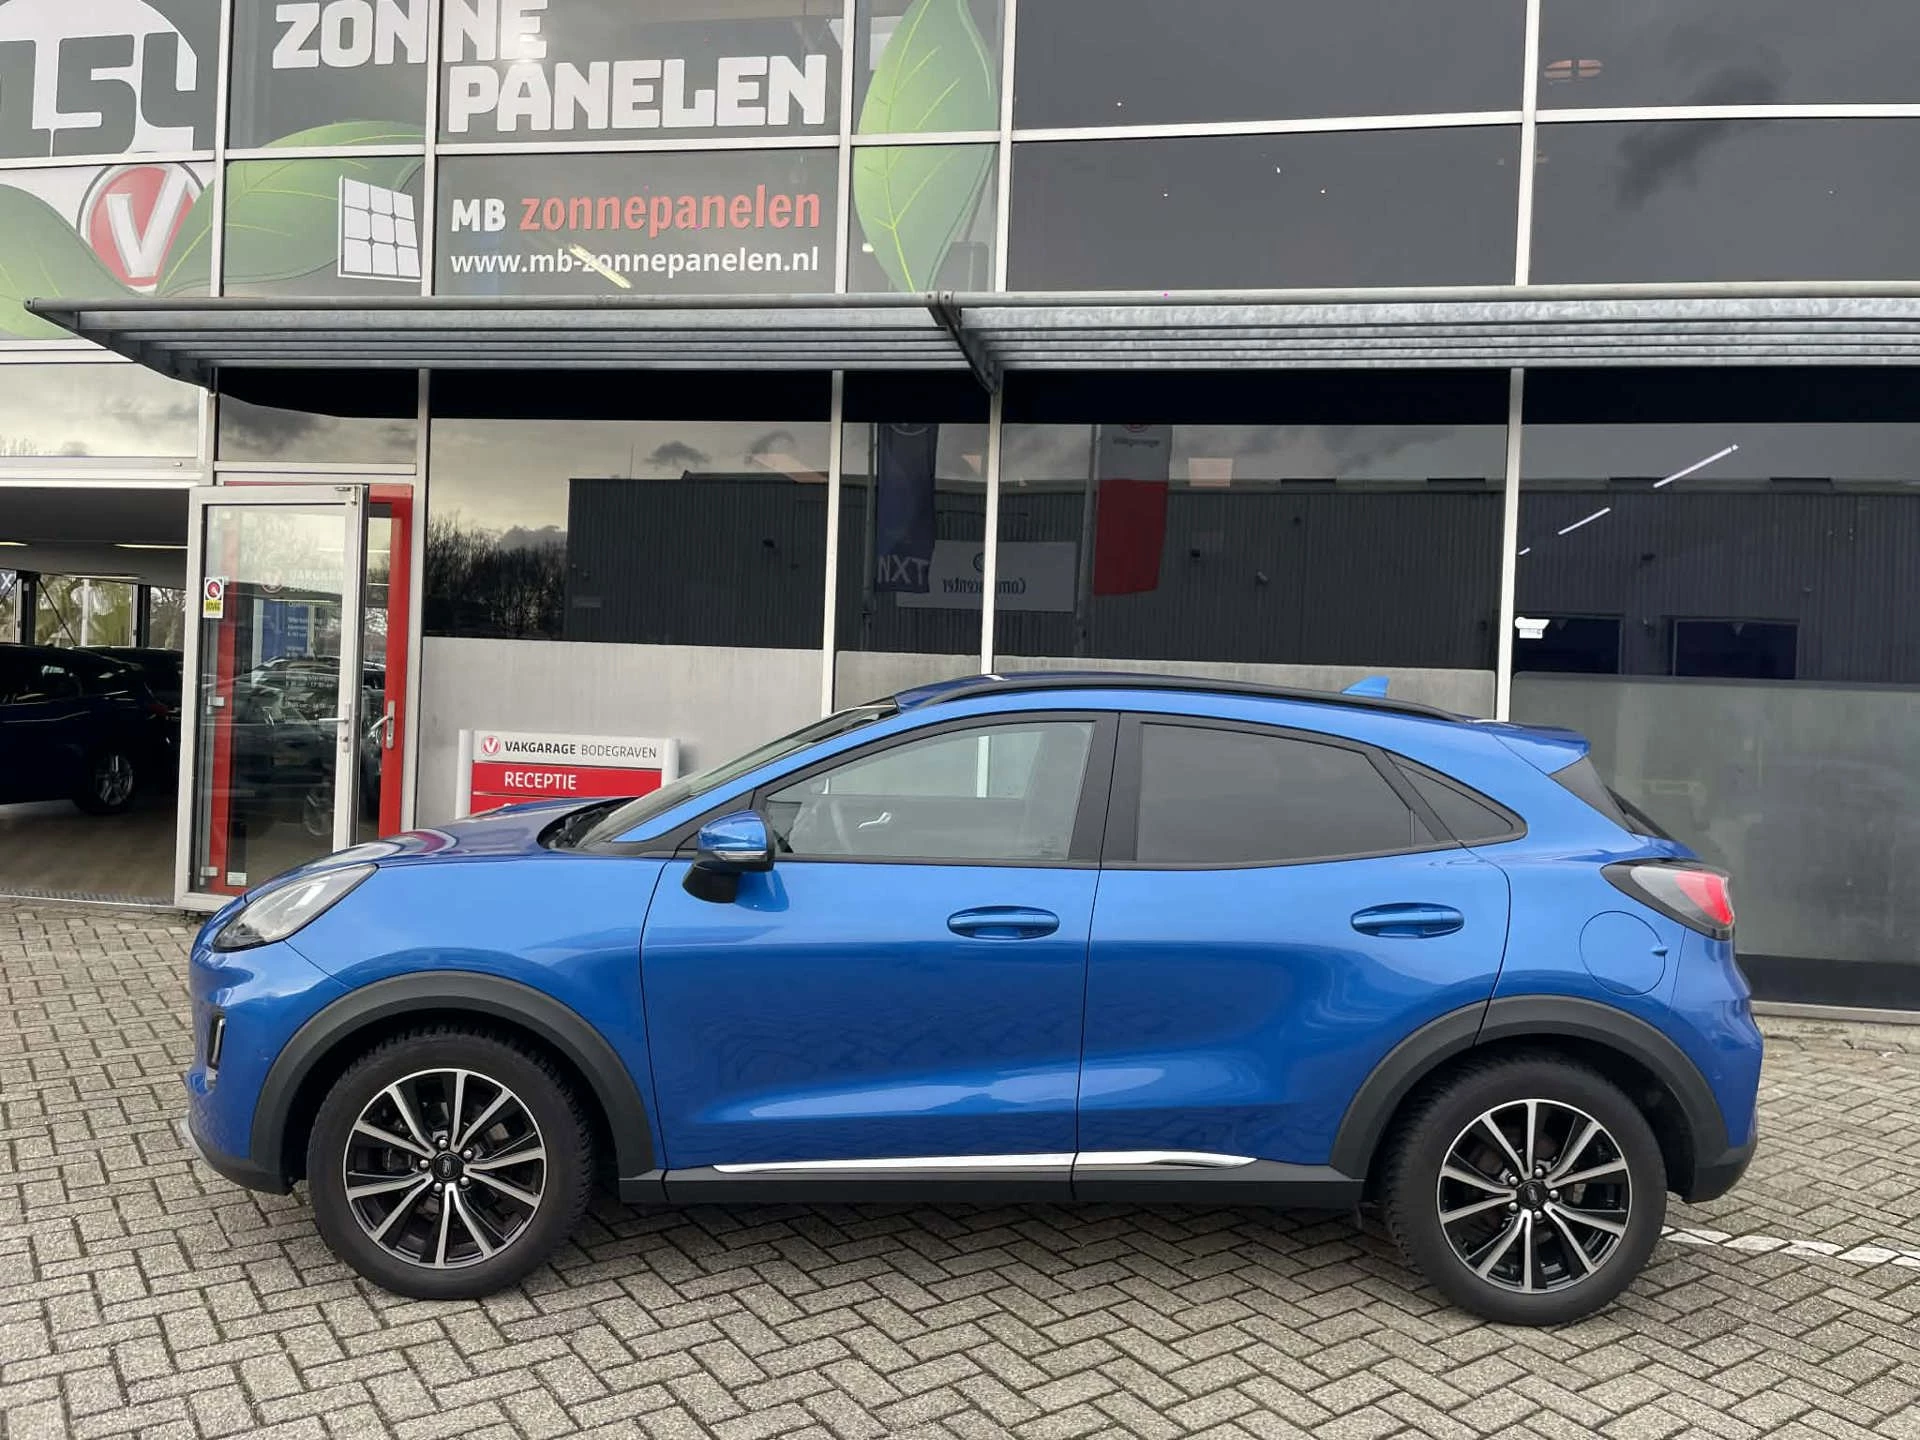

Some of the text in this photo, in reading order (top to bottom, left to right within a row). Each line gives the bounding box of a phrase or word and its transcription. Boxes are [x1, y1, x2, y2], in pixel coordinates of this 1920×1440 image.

[447, 54, 826, 133] PANELEN
[451, 184, 820, 238] MB zonnepanelen
[450, 246, 818, 277] www.mb-zonnepanelen.nl
[505, 741, 576, 755] VAKGARAGE
[581, 744, 657, 759] BODEGRAVEN
[504, 771, 577, 790] RECEPTIE
